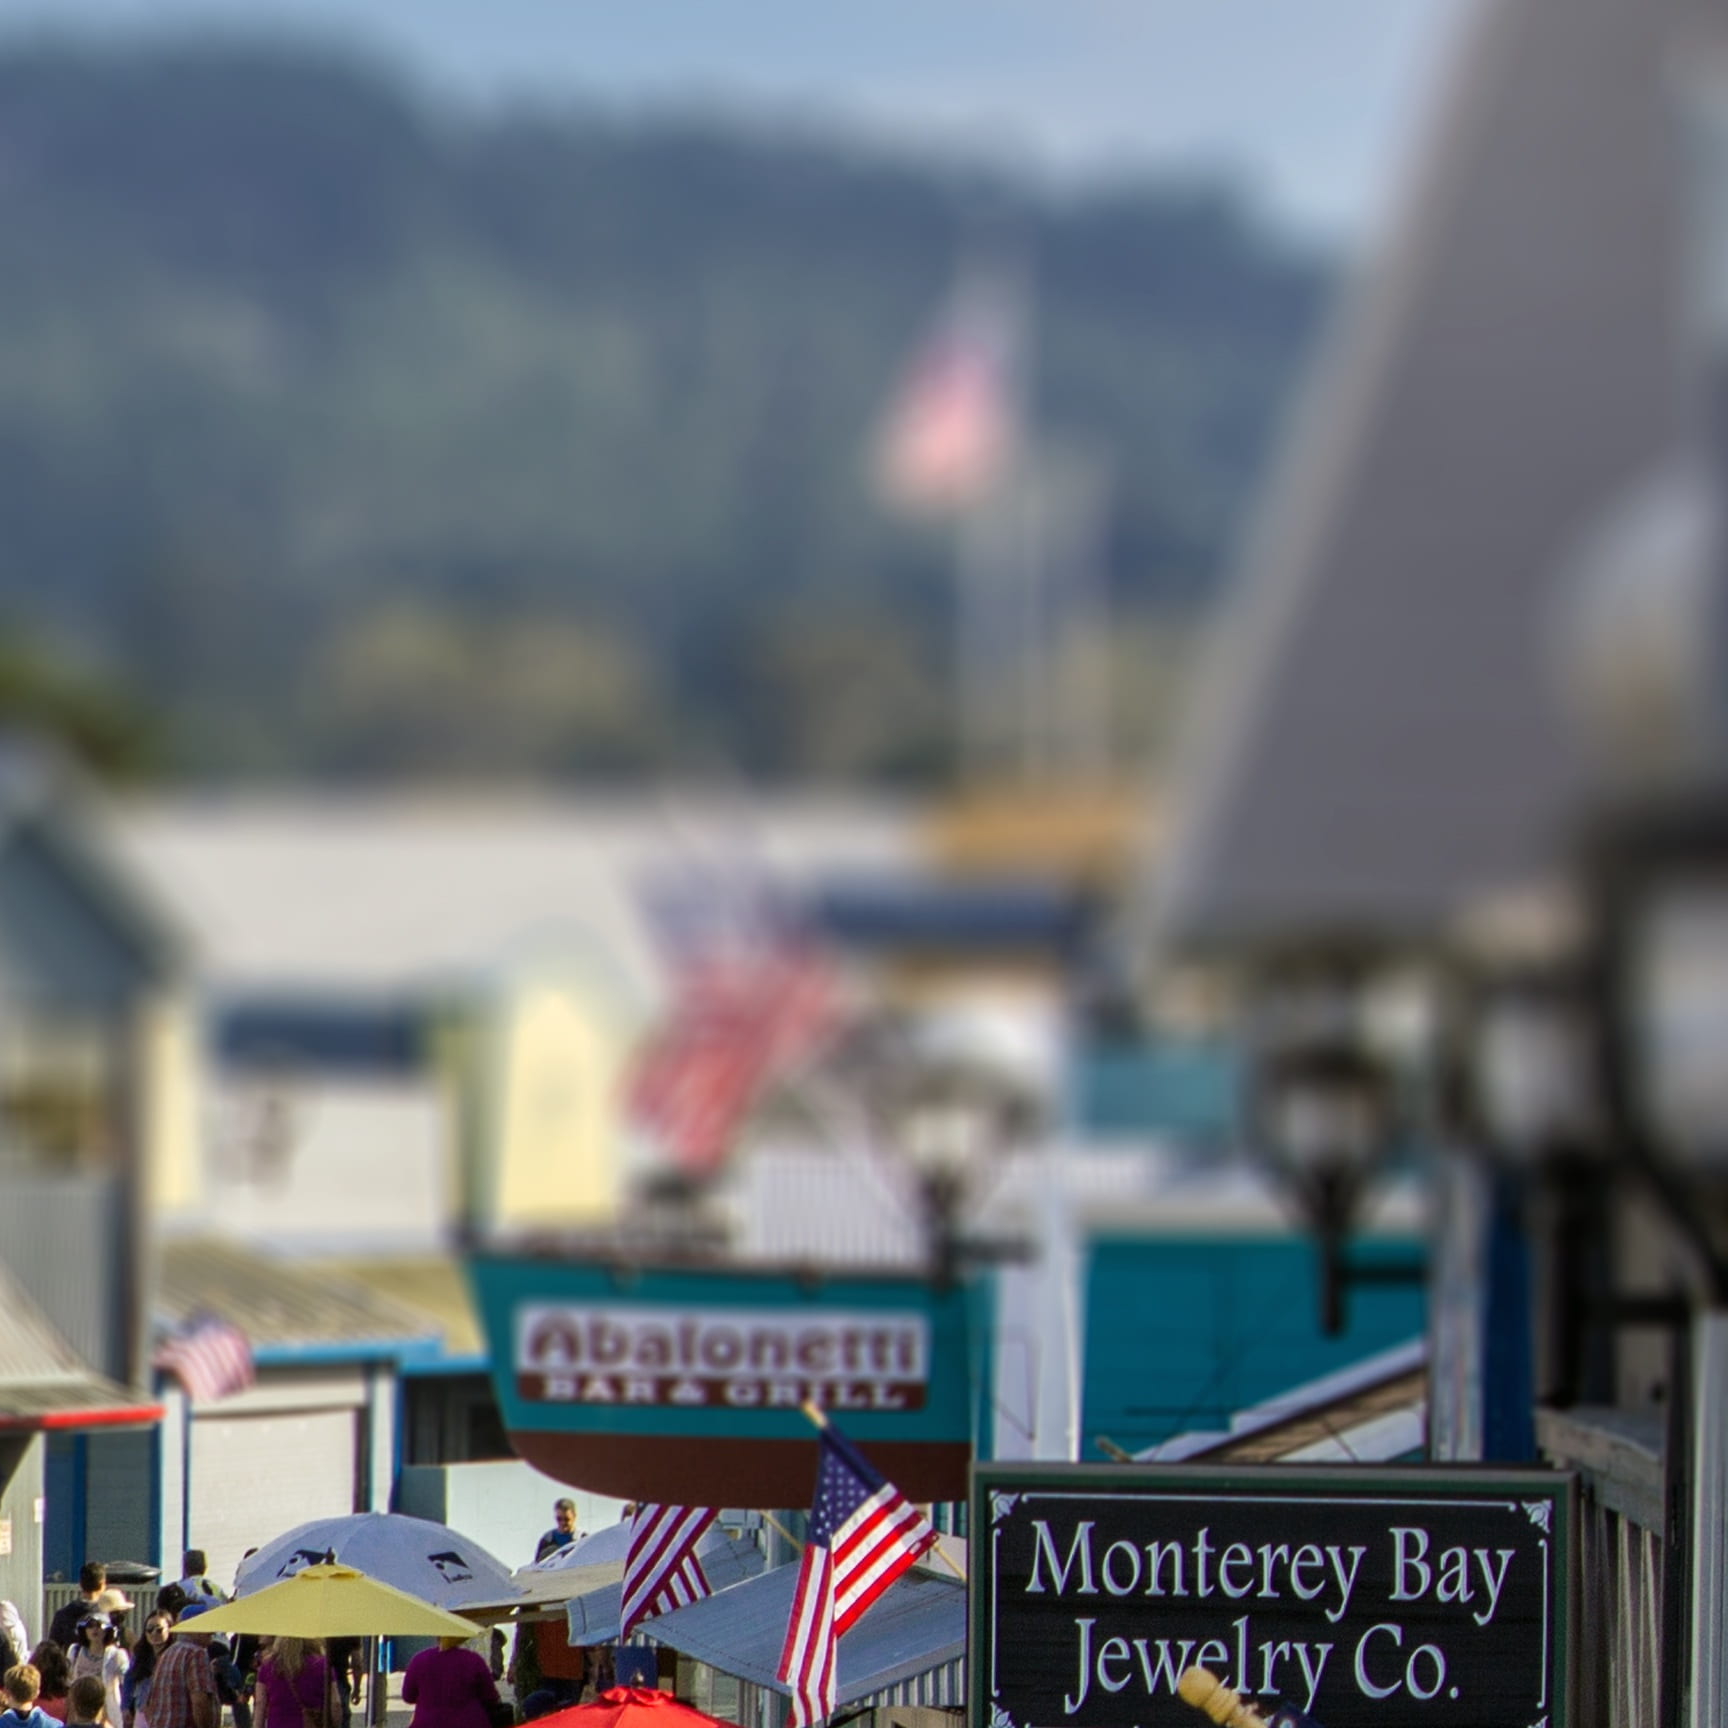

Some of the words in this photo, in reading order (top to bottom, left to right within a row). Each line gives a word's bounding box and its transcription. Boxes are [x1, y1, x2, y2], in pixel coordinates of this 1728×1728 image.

[528, 1310, 919, 1374] Abalonetti
[544, 1377, 657, 1403] BAR
[669, 1379, 705, 1404] &
[724, 1381, 906, 1408] GRILL
[1025, 1520, 1366, 1622] Monterey
[1388, 1527, 1515, 1626] Bay
[1354, 1623, 1459, 1699] Co.
